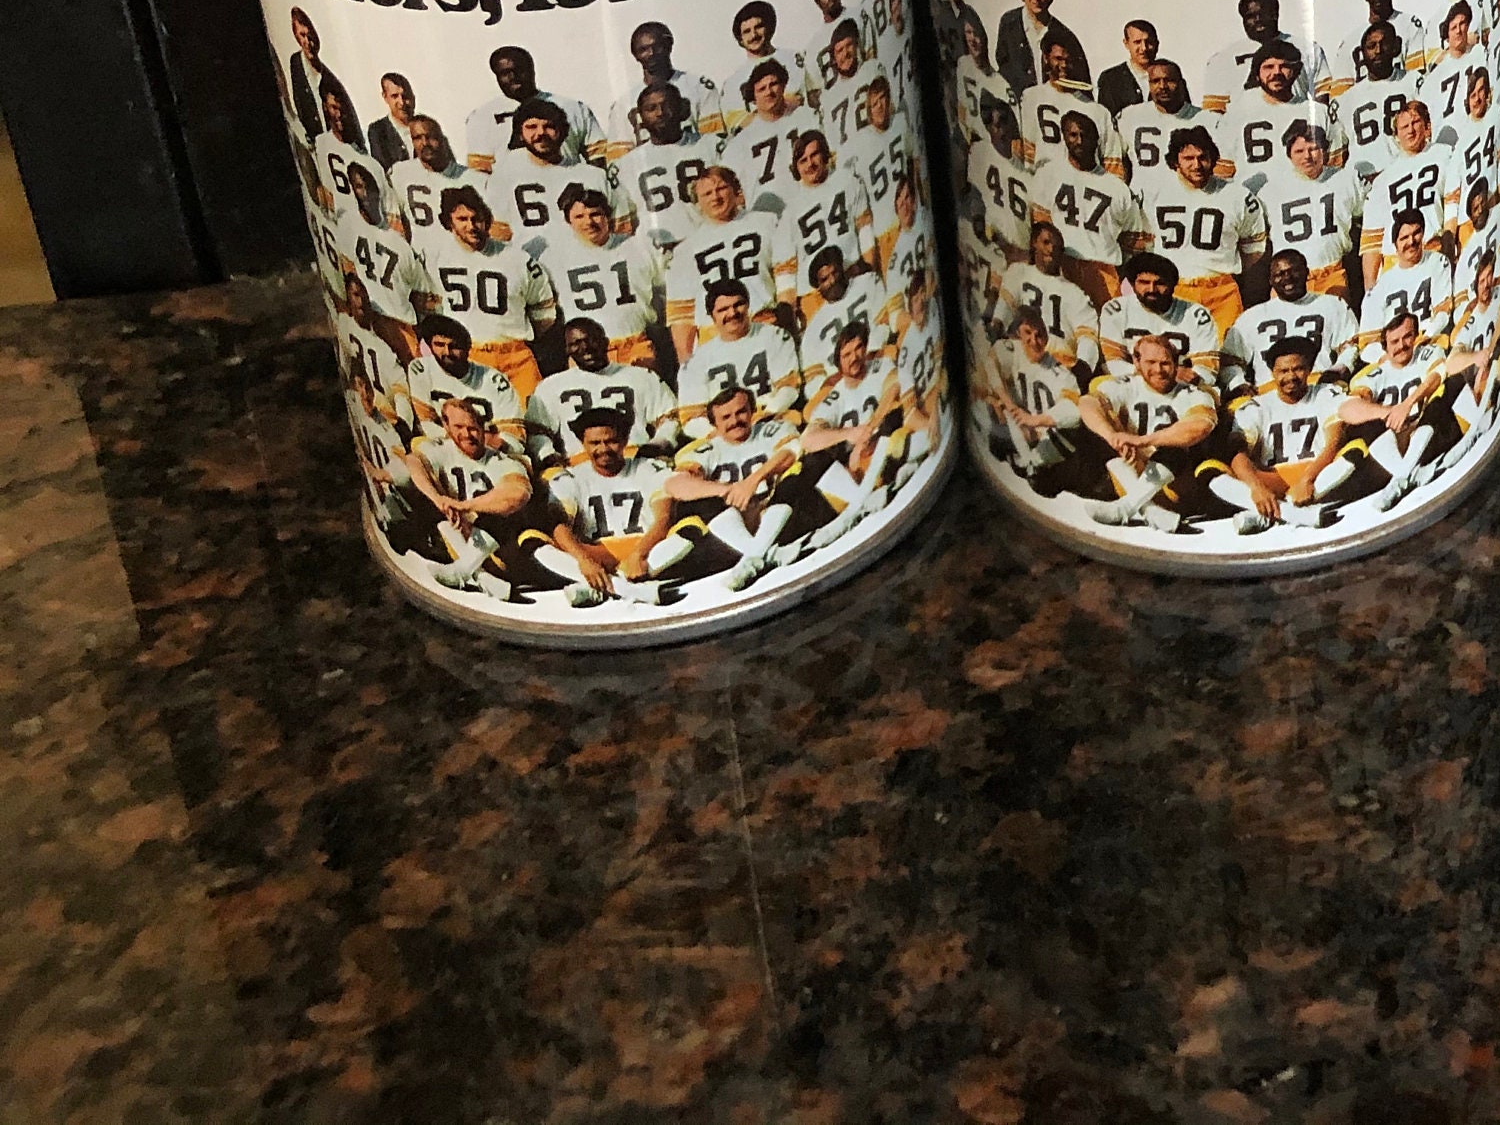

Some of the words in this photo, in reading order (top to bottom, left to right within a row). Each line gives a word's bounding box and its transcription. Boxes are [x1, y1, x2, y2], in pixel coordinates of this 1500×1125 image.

[1464, 125, 1496, 185] 54
[985, 164, 1029, 222] 46
[1055, 182, 1112, 234] 47
[1389, 163, 1440, 220] 52
[798, 191, 849, 256] 54
[1156, 205, 1225, 251] 50
[1281, 192, 1338, 244] 51
[355, 236, 399, 290] 47
[567, 260, 636, 312] 51
[694, 232, 762, 291] 52
[438, 267, 509, 315] 50
[708, 349, 772, 398] 34
[1267, 416, 1319, 466] 17
[588, 491, 645, 540] 17
